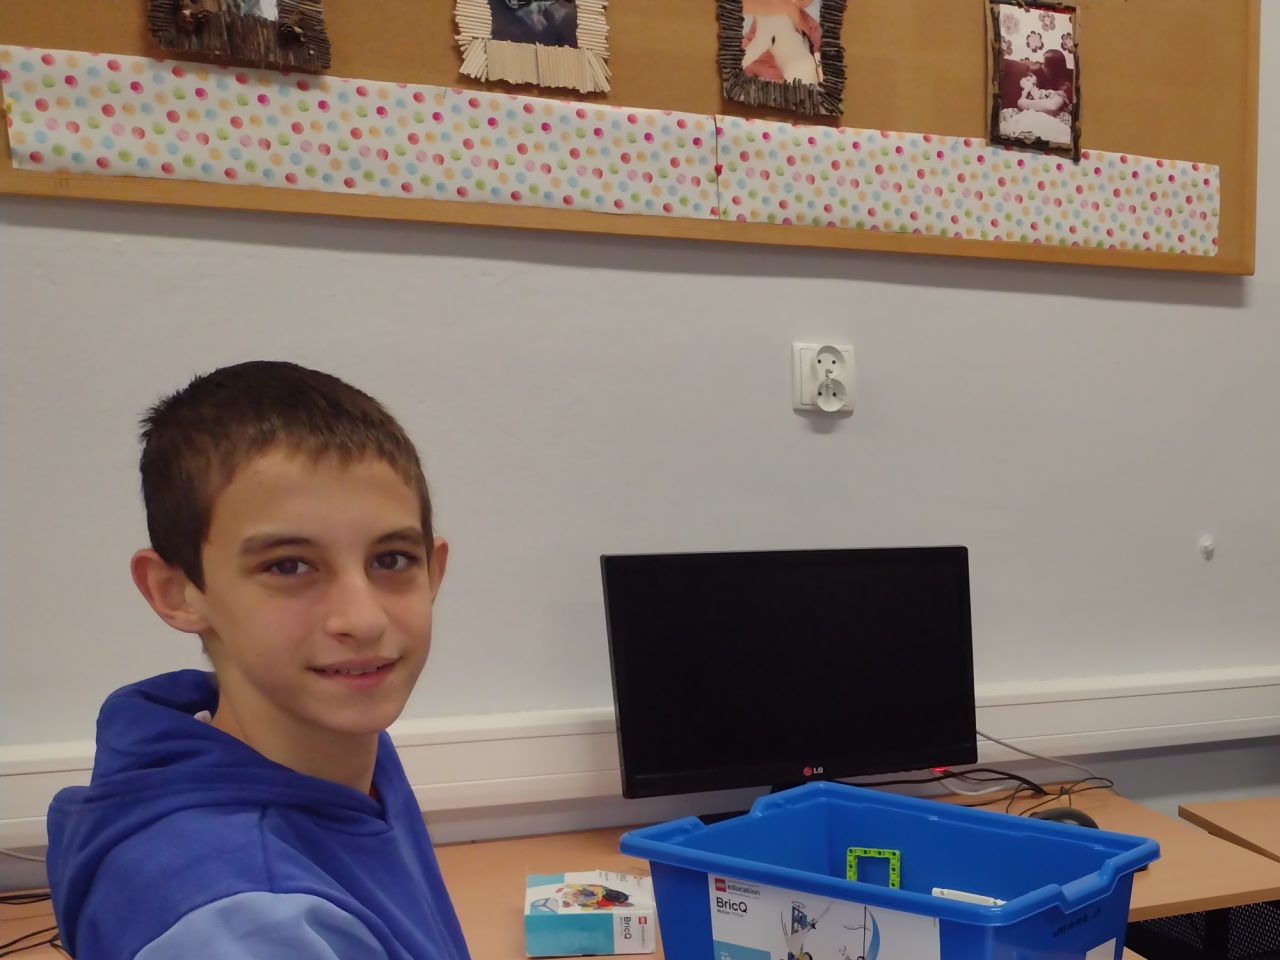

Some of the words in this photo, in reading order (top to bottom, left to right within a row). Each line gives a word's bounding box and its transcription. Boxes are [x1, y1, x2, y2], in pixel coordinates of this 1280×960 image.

[727, 883, 760, 896] education
[716, 896, 748, 914] BricQ
[623, 916, 632, 940] BricQ
